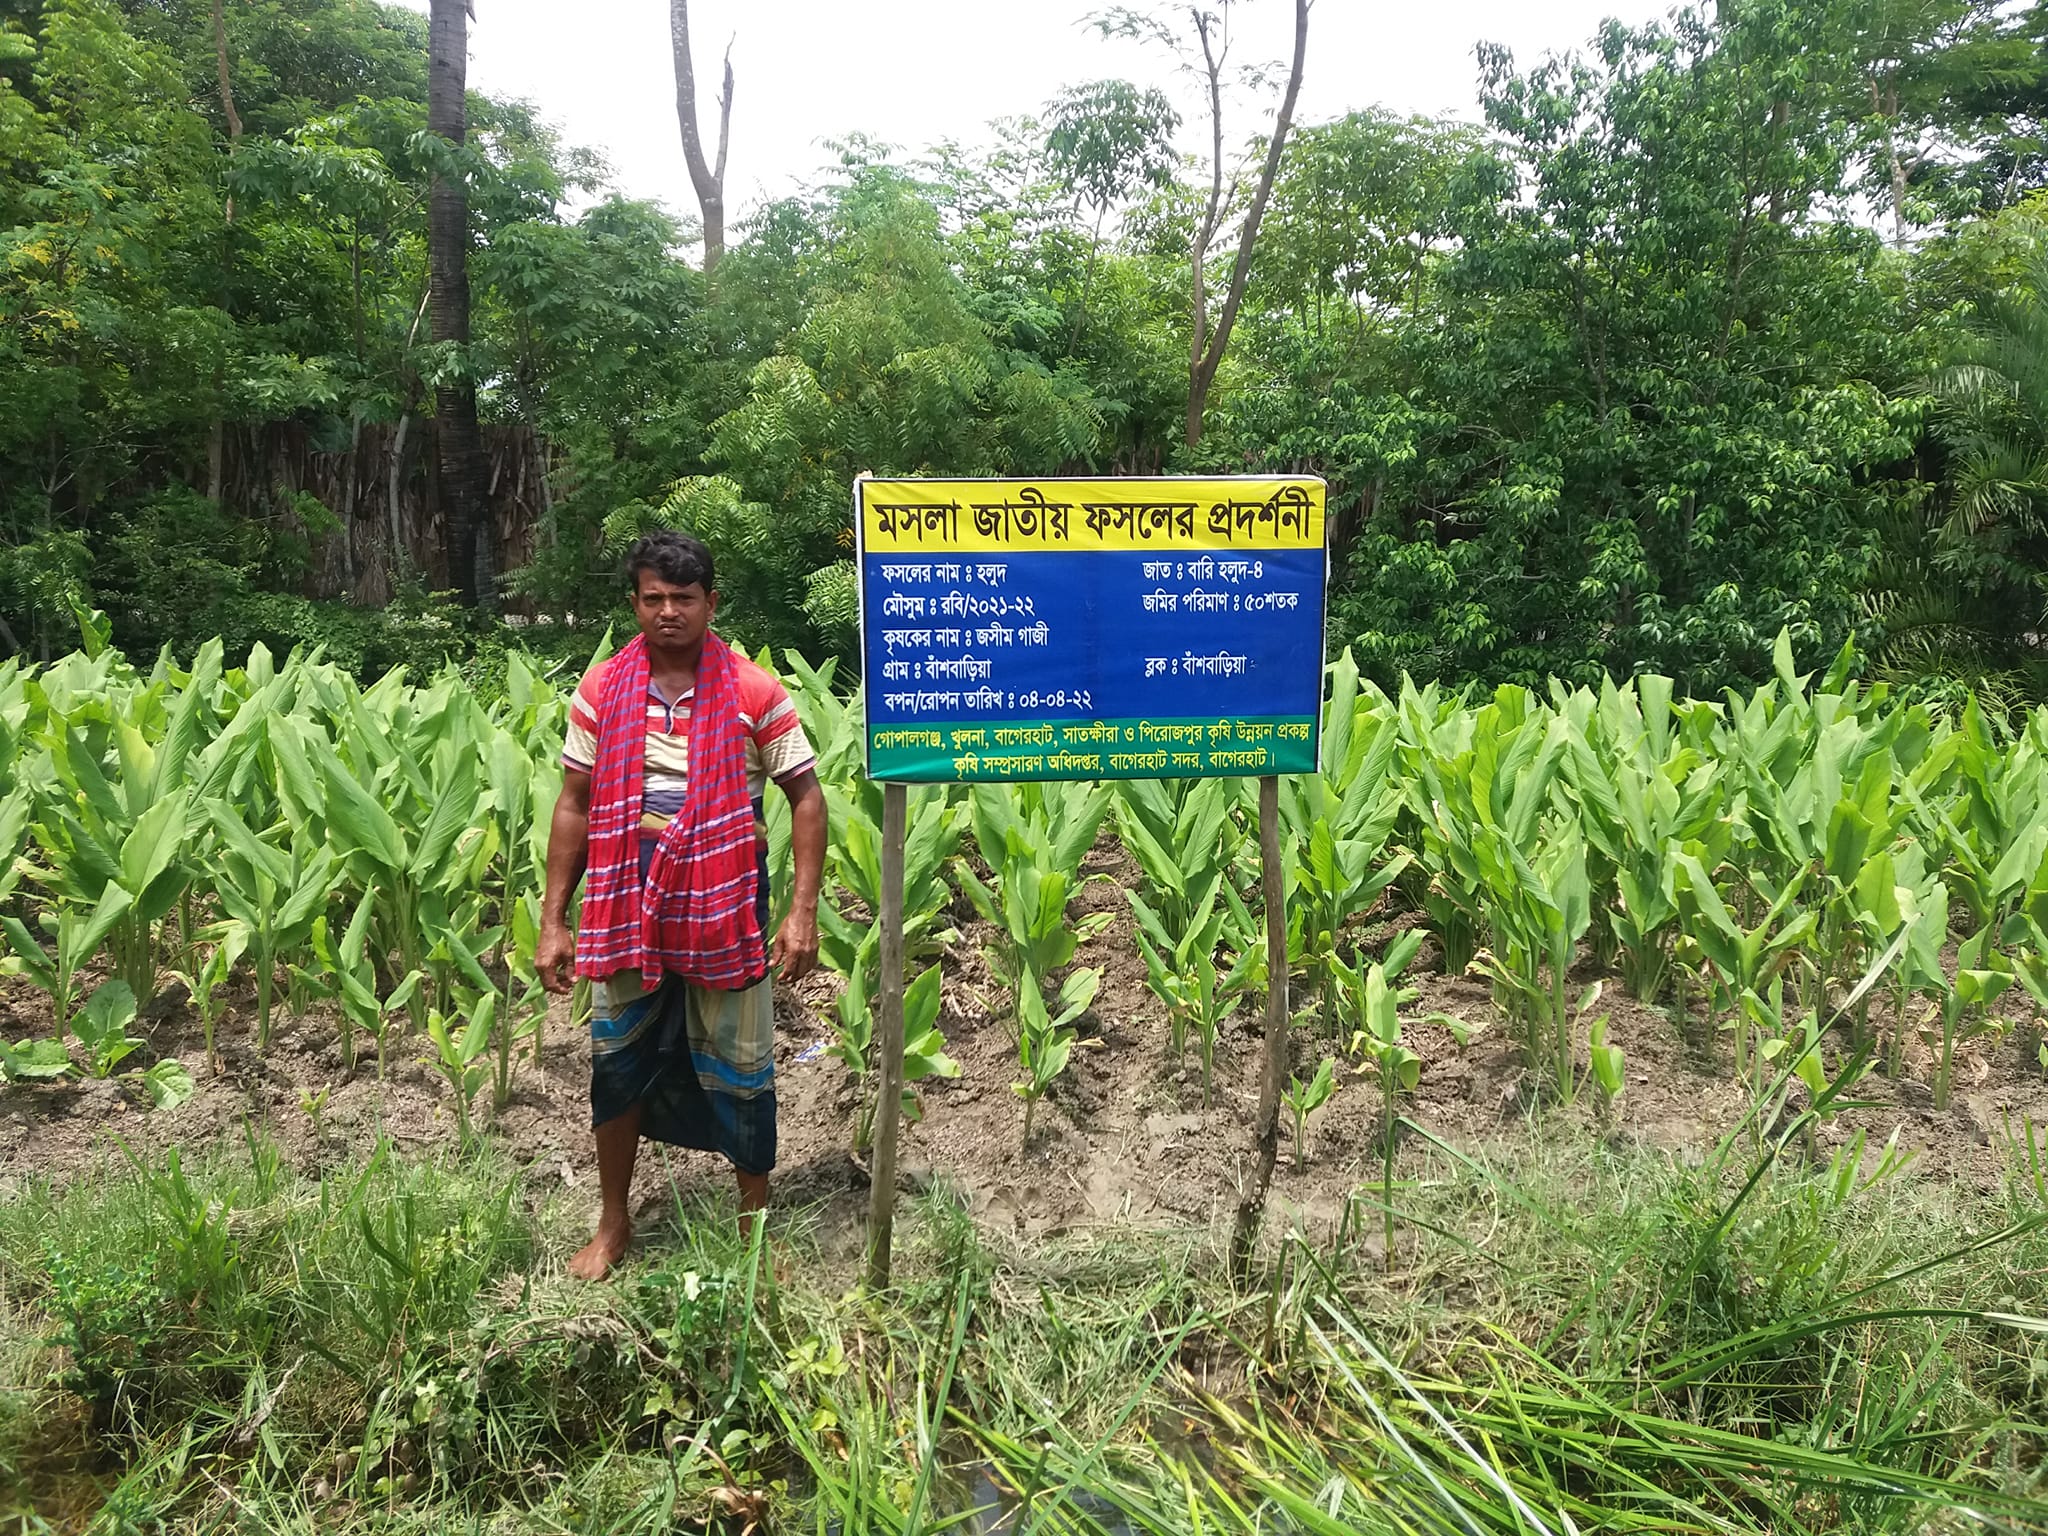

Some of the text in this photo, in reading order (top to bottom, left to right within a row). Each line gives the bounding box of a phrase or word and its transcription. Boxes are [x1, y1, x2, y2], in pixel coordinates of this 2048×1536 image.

[871, 486, 1316, 542] মসলা জাতীয় ফসলের প্রদর্শনী
[881, 564, 932, 583] ফসলের
[935, 562, 961, 583] নাম
[976, 563, 1008, 587] হলুদ
[1142, 560, 1172, 581] জাত
[1187, 555, 1215, 581] বারি
[1218, 561, 1263, 584] হলুদ-৪
[883, 590, 926, 620] মৌসুম
[940, 590, 1035, 618] রবি/২০২১-২২
[1142, 588, 1178, 613] জমির
[1182, 588, 1229, 613] পরিমাণ
[1244, 591, 1299, 611] ৫০শতক
[882, 629, 932, 655] কৃষকের
[935, 627, 961, 648] নাম
[975, 621, 1014, 648] জসীম
[1018, 621, 1050, 647] গাজী
[882, 661, 910, 680] গ্রাম
[924, 654, 992, 681] বাঁশবাড়িয়া
[1144, 656, 1167, 678] ব্লক
[1182, 650, 1247, 678] বাঁশবাড়িয়া
[883, 689, 959, 714] বপন/রোপন
[963, 685, 1004, 711] তারিখ
[1019, 689, 1093, 710] ০৪-০৪-২২
[874, 720, 1311, 751] গোপালগঞ্জ, খুলনা, বাগেরহাট, সাতক্ষীরা ও পিরোজপুর কৃষি উন্নয়ন প্রকল্প
[952, 752, 979, 779] কৃষি
[983, 754, 1043, 775] সম্প্রসারণ
[1047, 750, 1104, 774] অধিদপ্তর,
[1109, 748, 1167, 771] বাগেরহাট
[1172, 752, 1204, 772] সদর,
[1209, 747, 1268, 770] বাগেরহাট
